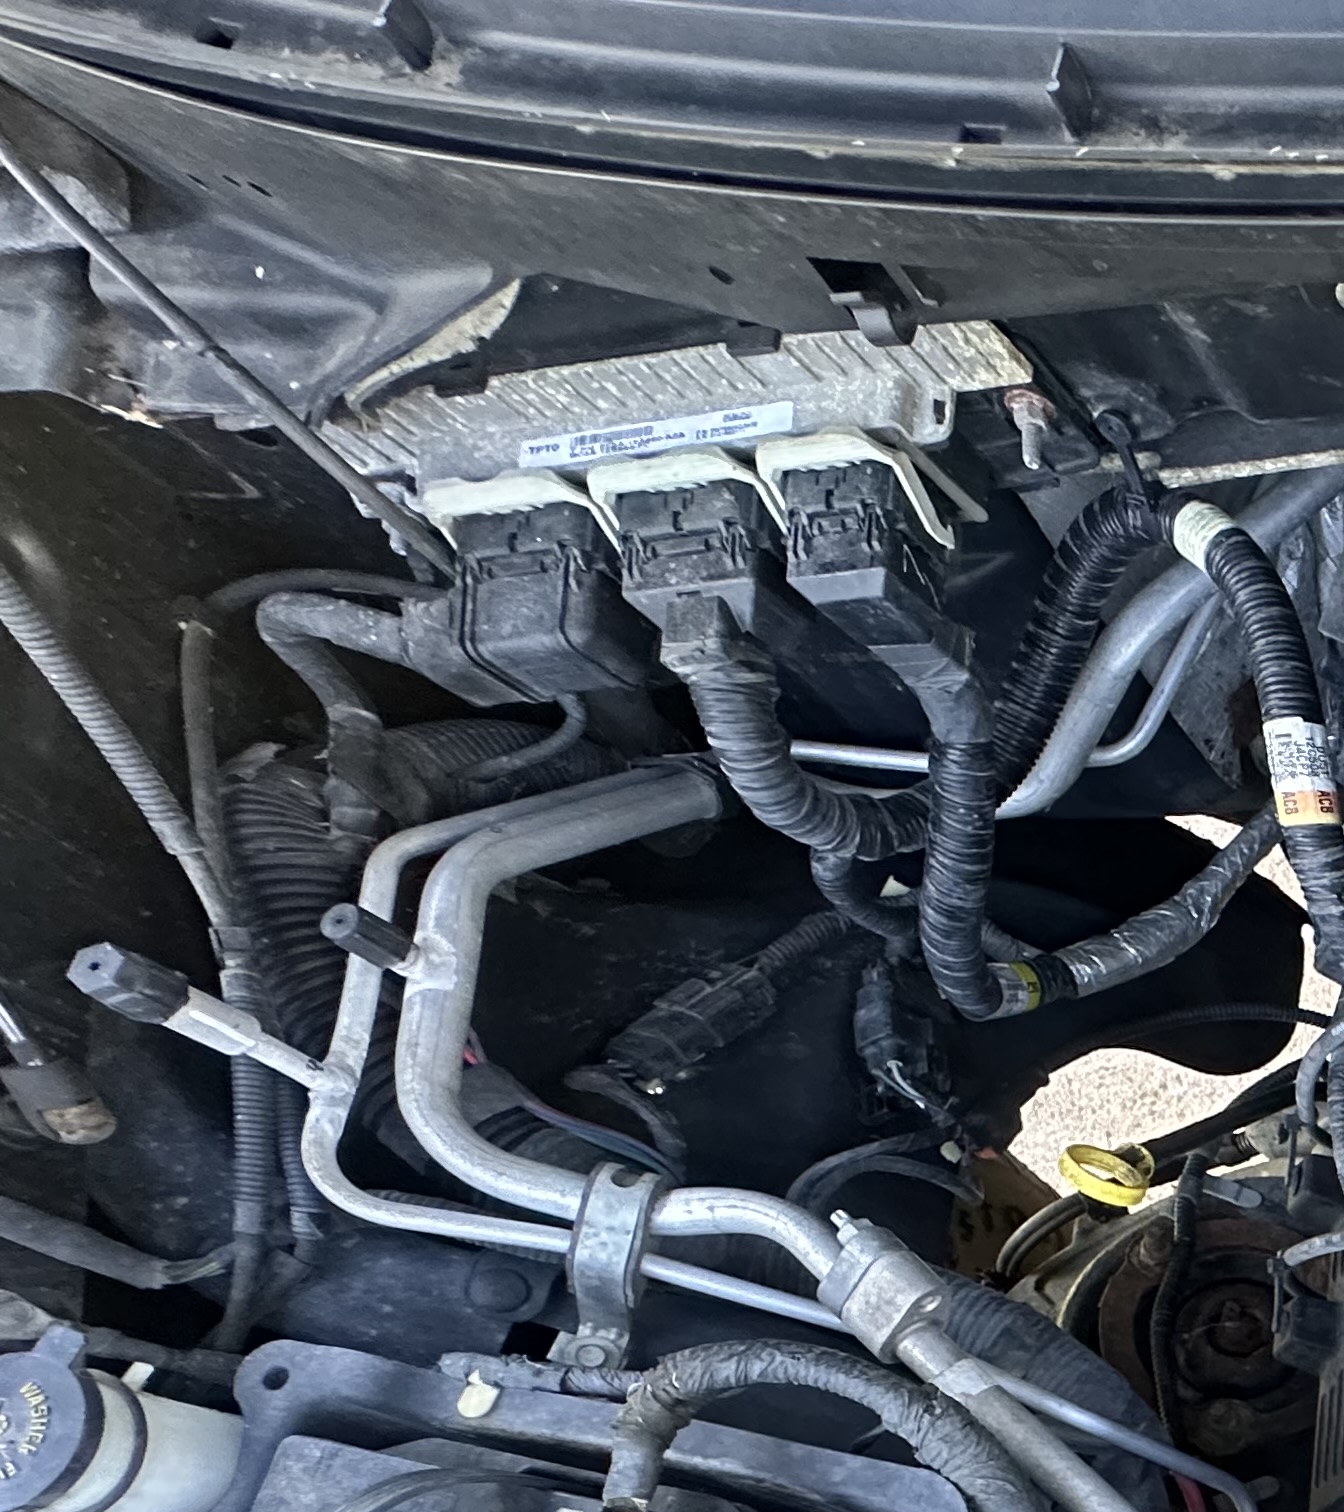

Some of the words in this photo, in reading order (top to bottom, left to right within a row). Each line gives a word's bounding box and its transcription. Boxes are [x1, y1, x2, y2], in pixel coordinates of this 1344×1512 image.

[1280, 789, 1299, 815] ACB
[1316, 787, 1334, 815] ACB
[18, 1381, 49, 1456] WASHER
